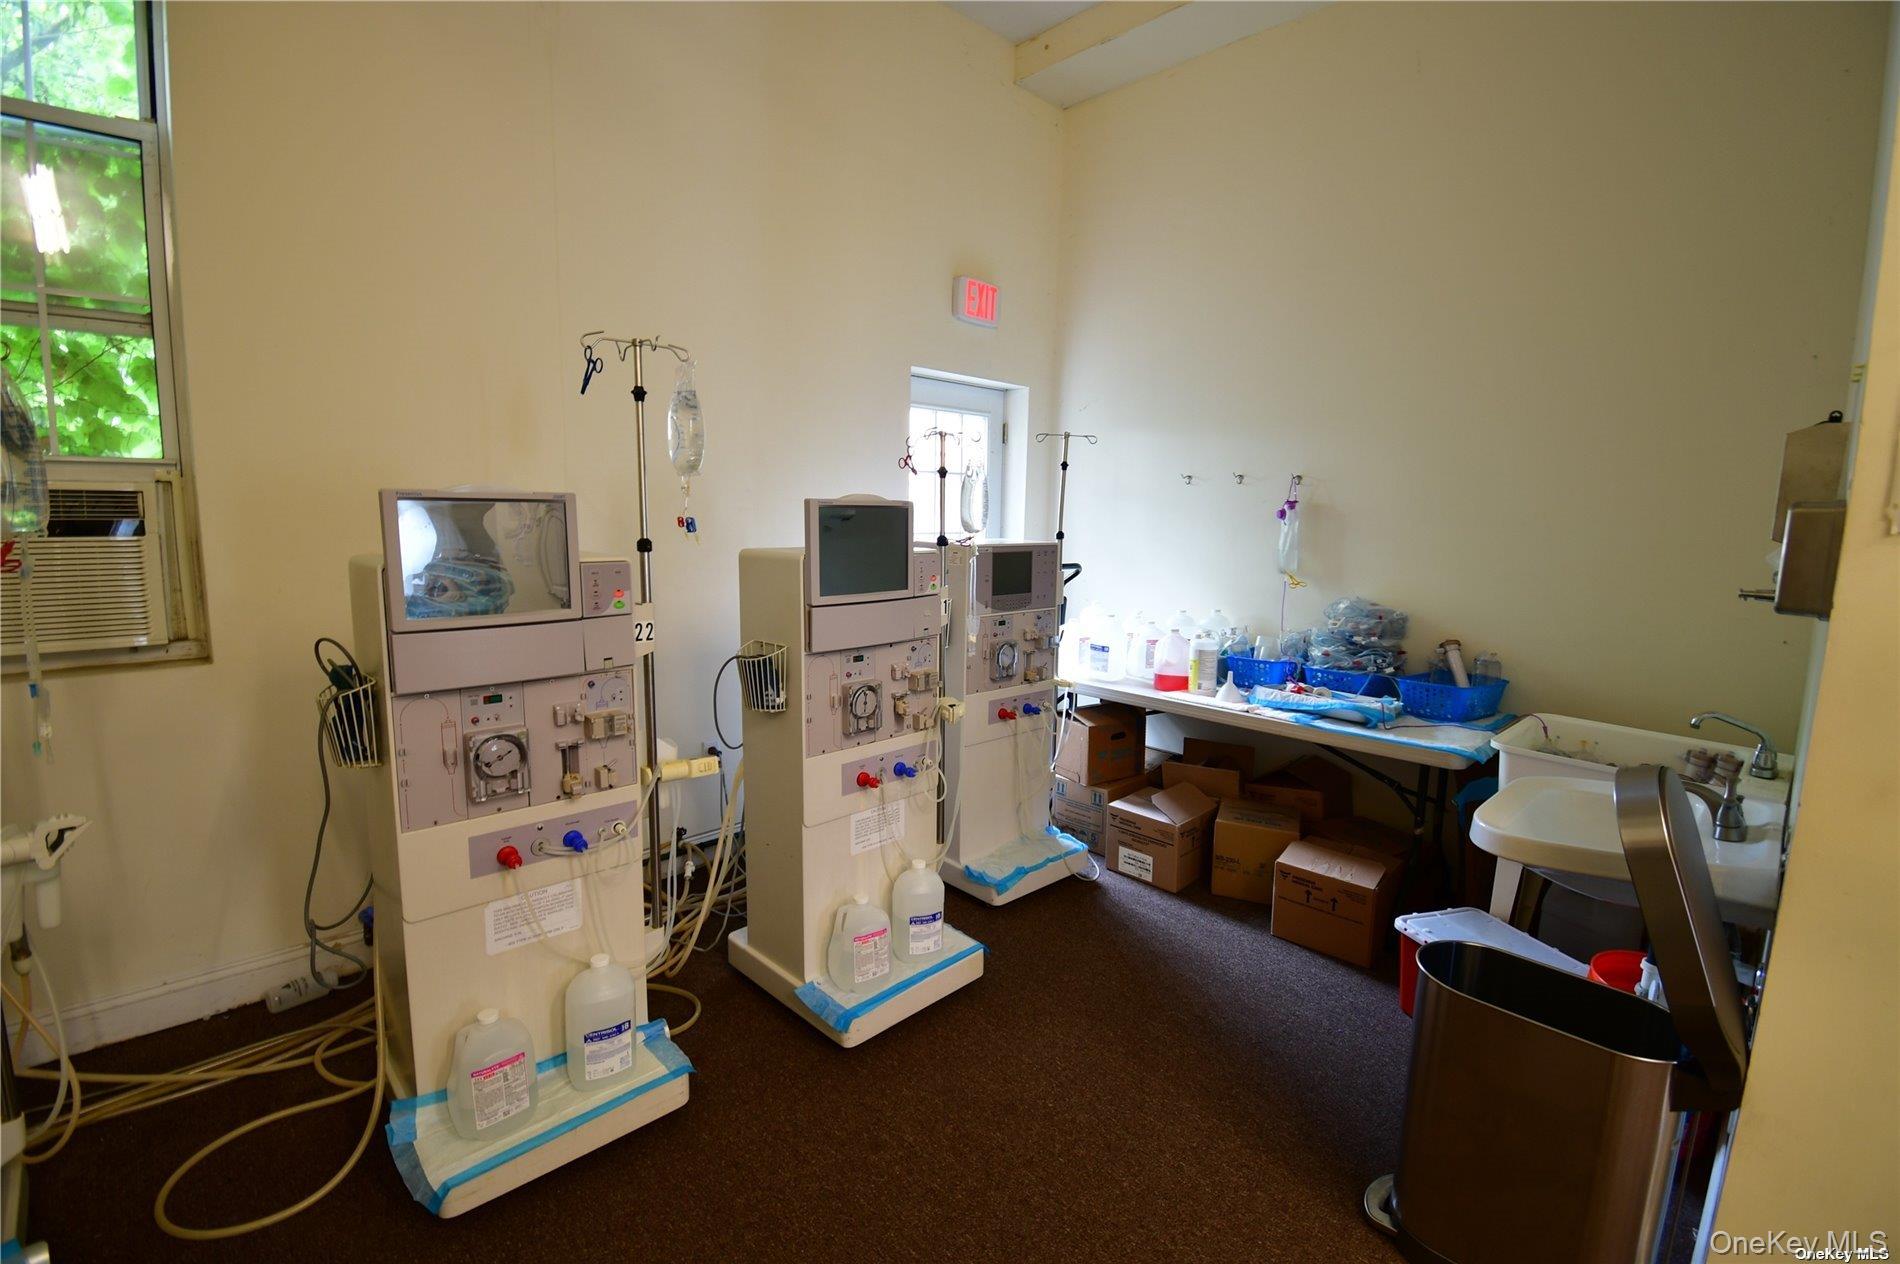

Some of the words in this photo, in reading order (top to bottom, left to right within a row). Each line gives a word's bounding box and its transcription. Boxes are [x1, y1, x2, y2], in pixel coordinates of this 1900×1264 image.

[967, 280, 998, 321] EXIT
[635, 622, 654, 641] 22
[520, 889, 548, 901] CUTION
